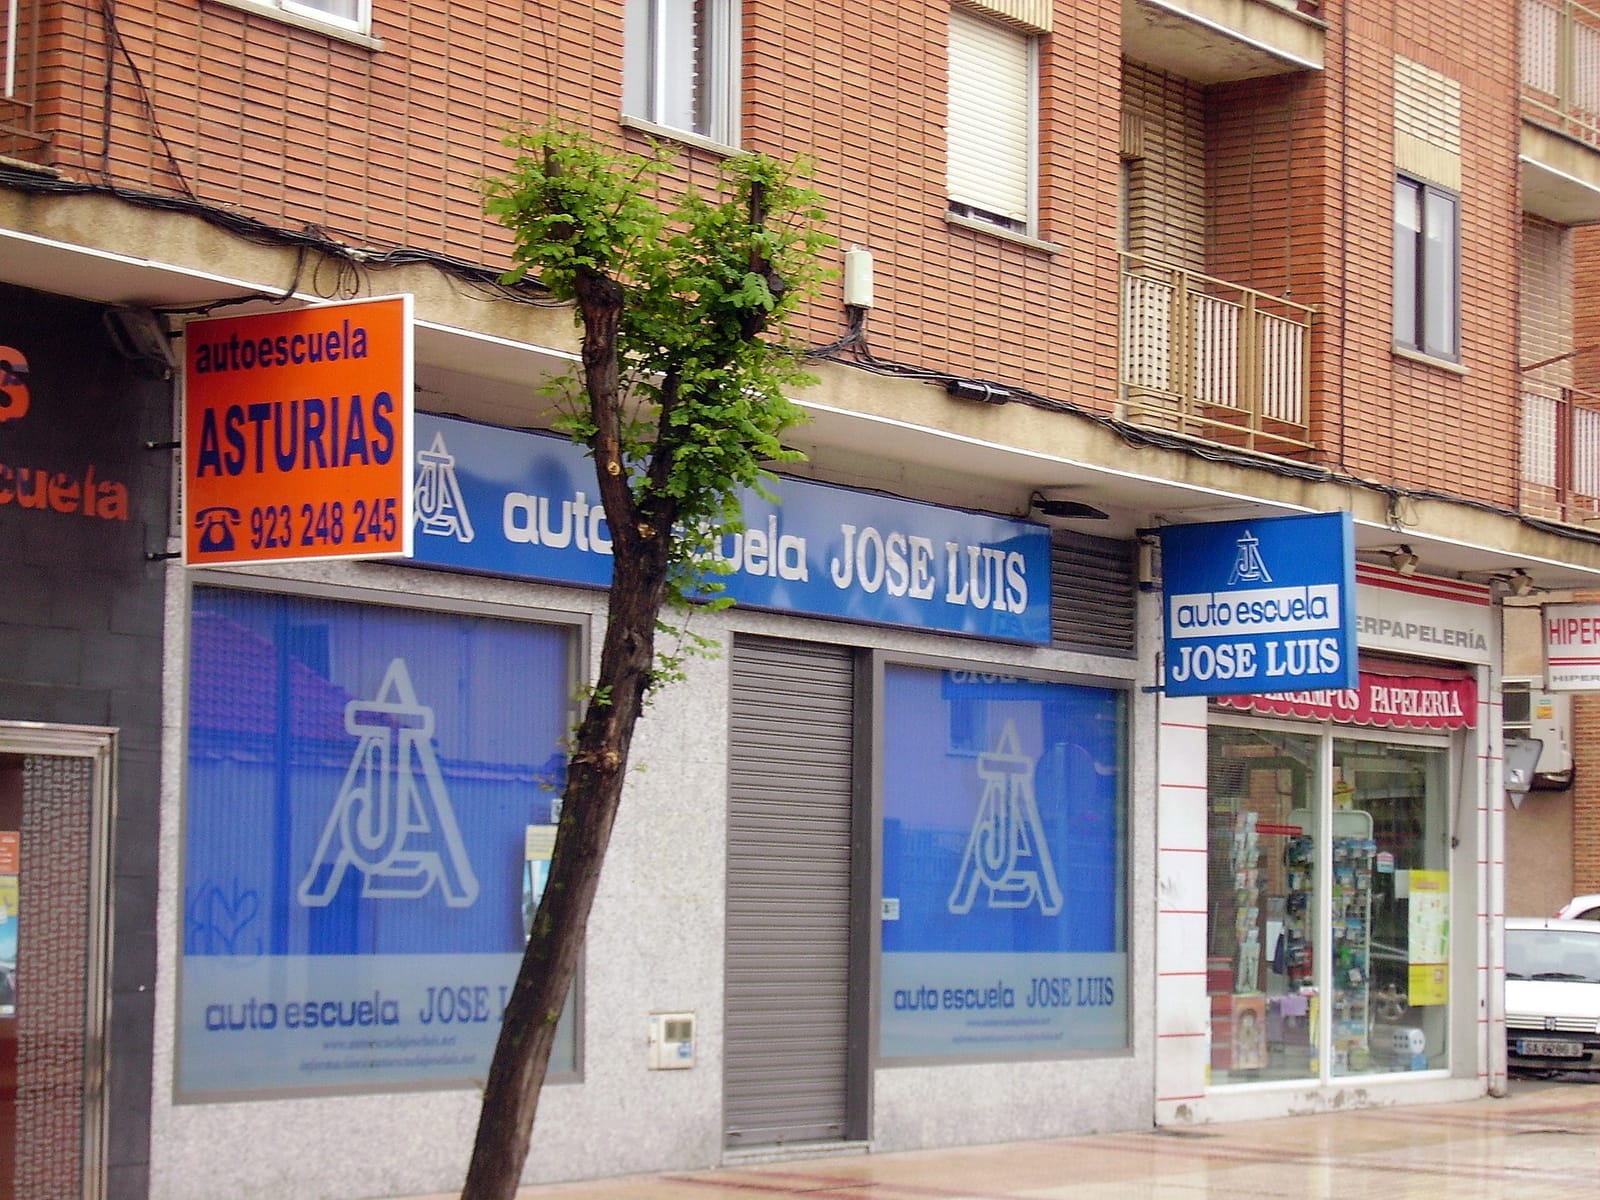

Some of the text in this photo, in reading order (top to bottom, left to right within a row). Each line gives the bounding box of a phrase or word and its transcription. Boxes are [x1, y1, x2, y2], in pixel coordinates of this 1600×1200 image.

[195, 319, 368, 374] autoescuela
[197, 391, 395, 478] ASTURIAS
[251, 498, 396, 549] 923 248 245
[831, 524, 936, 600] JOSE
[945, 541, 1028, 615] LUIS
[1178, 586, 1329, 628] auto escuela
[1172, 637, 1340, 682] JOSE LUIS
[1370, 685, 1463, 716] PAPELERIA
[205, 997, 278, 1031] auto
[284, 990, 399, 1029] escuela
[419, 985, 490, 1025] JOSE
[894, 976, 1115, 1011] auto escuela JOSE LUIS
